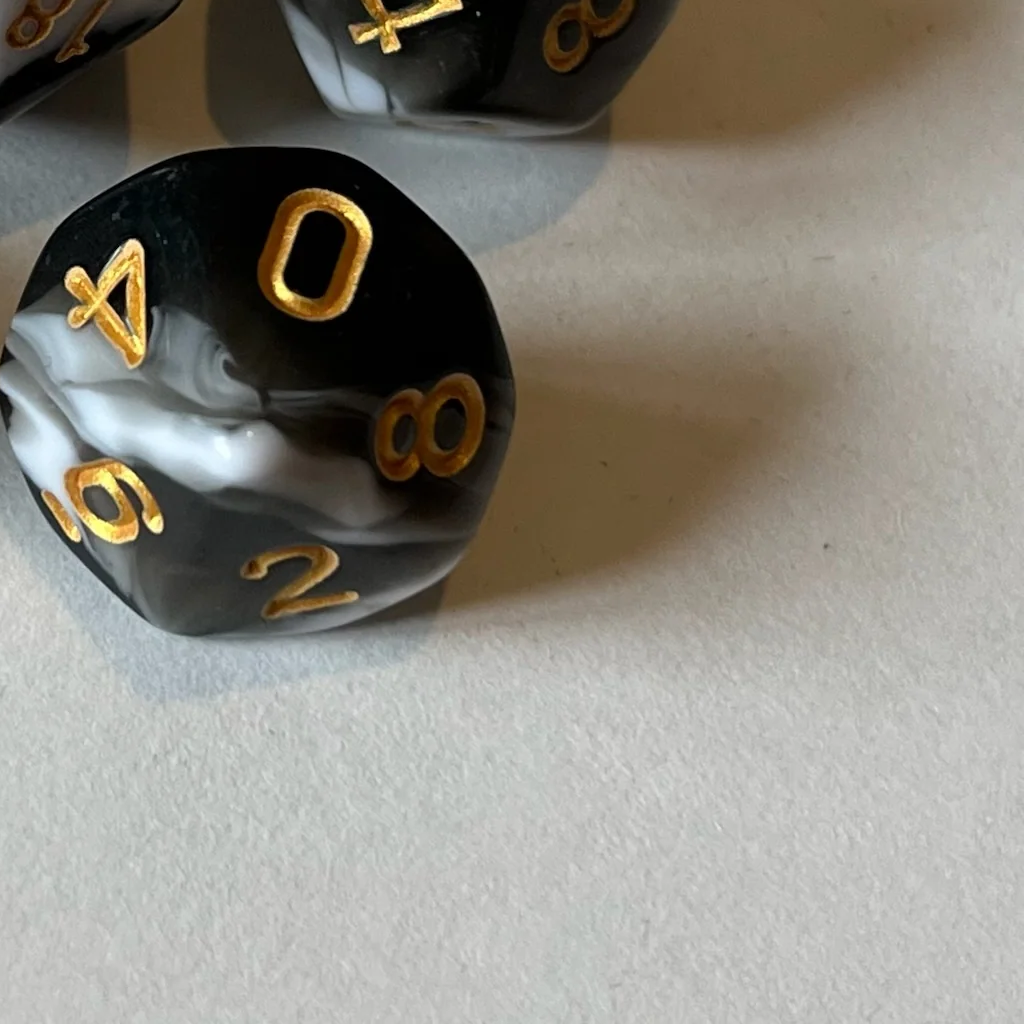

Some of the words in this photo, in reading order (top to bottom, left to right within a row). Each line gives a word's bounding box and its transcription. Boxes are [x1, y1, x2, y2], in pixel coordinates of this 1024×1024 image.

[64, 237, 147, 369] 4
[257, 187, 374, 321] 0
[376, 372, 487, 482] 8
[240, 544, 360, 619] 2
